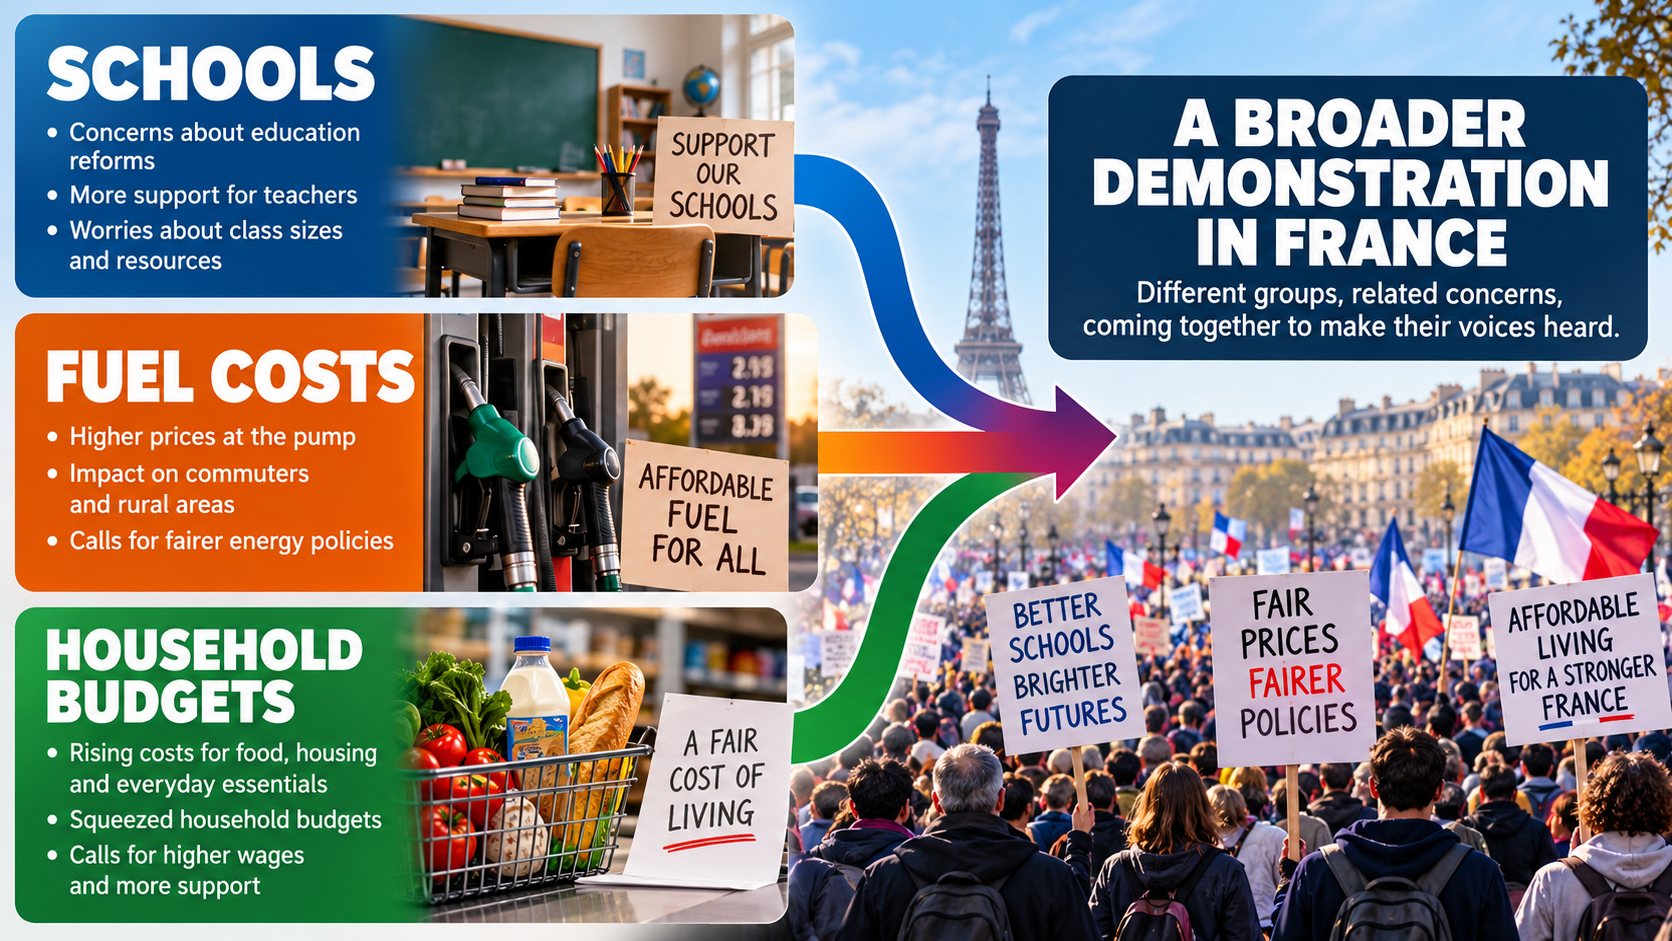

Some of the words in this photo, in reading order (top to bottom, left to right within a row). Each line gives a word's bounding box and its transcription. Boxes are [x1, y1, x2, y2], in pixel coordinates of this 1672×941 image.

[671, 131, 776, 158] SUPPORT
[696, 162, 742, 186] OUR
[669, 190, 778, 222] SCHOOLS
[638, 462, 774, 502] AFFORDABLE
[667, 499, 739, 535] FUEL
[652, 533, 704, 568] FOR
[715, 542, 767, 577] ALL
[1012, 591, 1103, 630] BETTER
[1252, 586, 1314, 621] FAIR
[1508, 590, 1641, 634] AFFORDABLE
[1008, 623, 1115, 664] SCHOOLS
[1240, 622, 1339, 660] PRICES
[1537, 626, 1614, 661] LIVING
[1013, 661, 1122, 700] BRIGHTER
[1248, 662, 1346, 700] FAIRER
[1508, 667, 1543, 695] FOR
[1546, 665, 1560, 689] A
[1563, 653, 1658, 687] STRONGER
[1019, 695, 1128, 733] FUTURES
[1240, 701, 1358, 740] POLICIES
[1541, 685, 1629, 722] FRANCE
[682, 729, 699, 757] A
[710, 727, 759, 755] FAIR
[669, 764, 726, 793] COST
[735, 762, 766, 790] OF
[667, 798, 755, 832] LIVING
